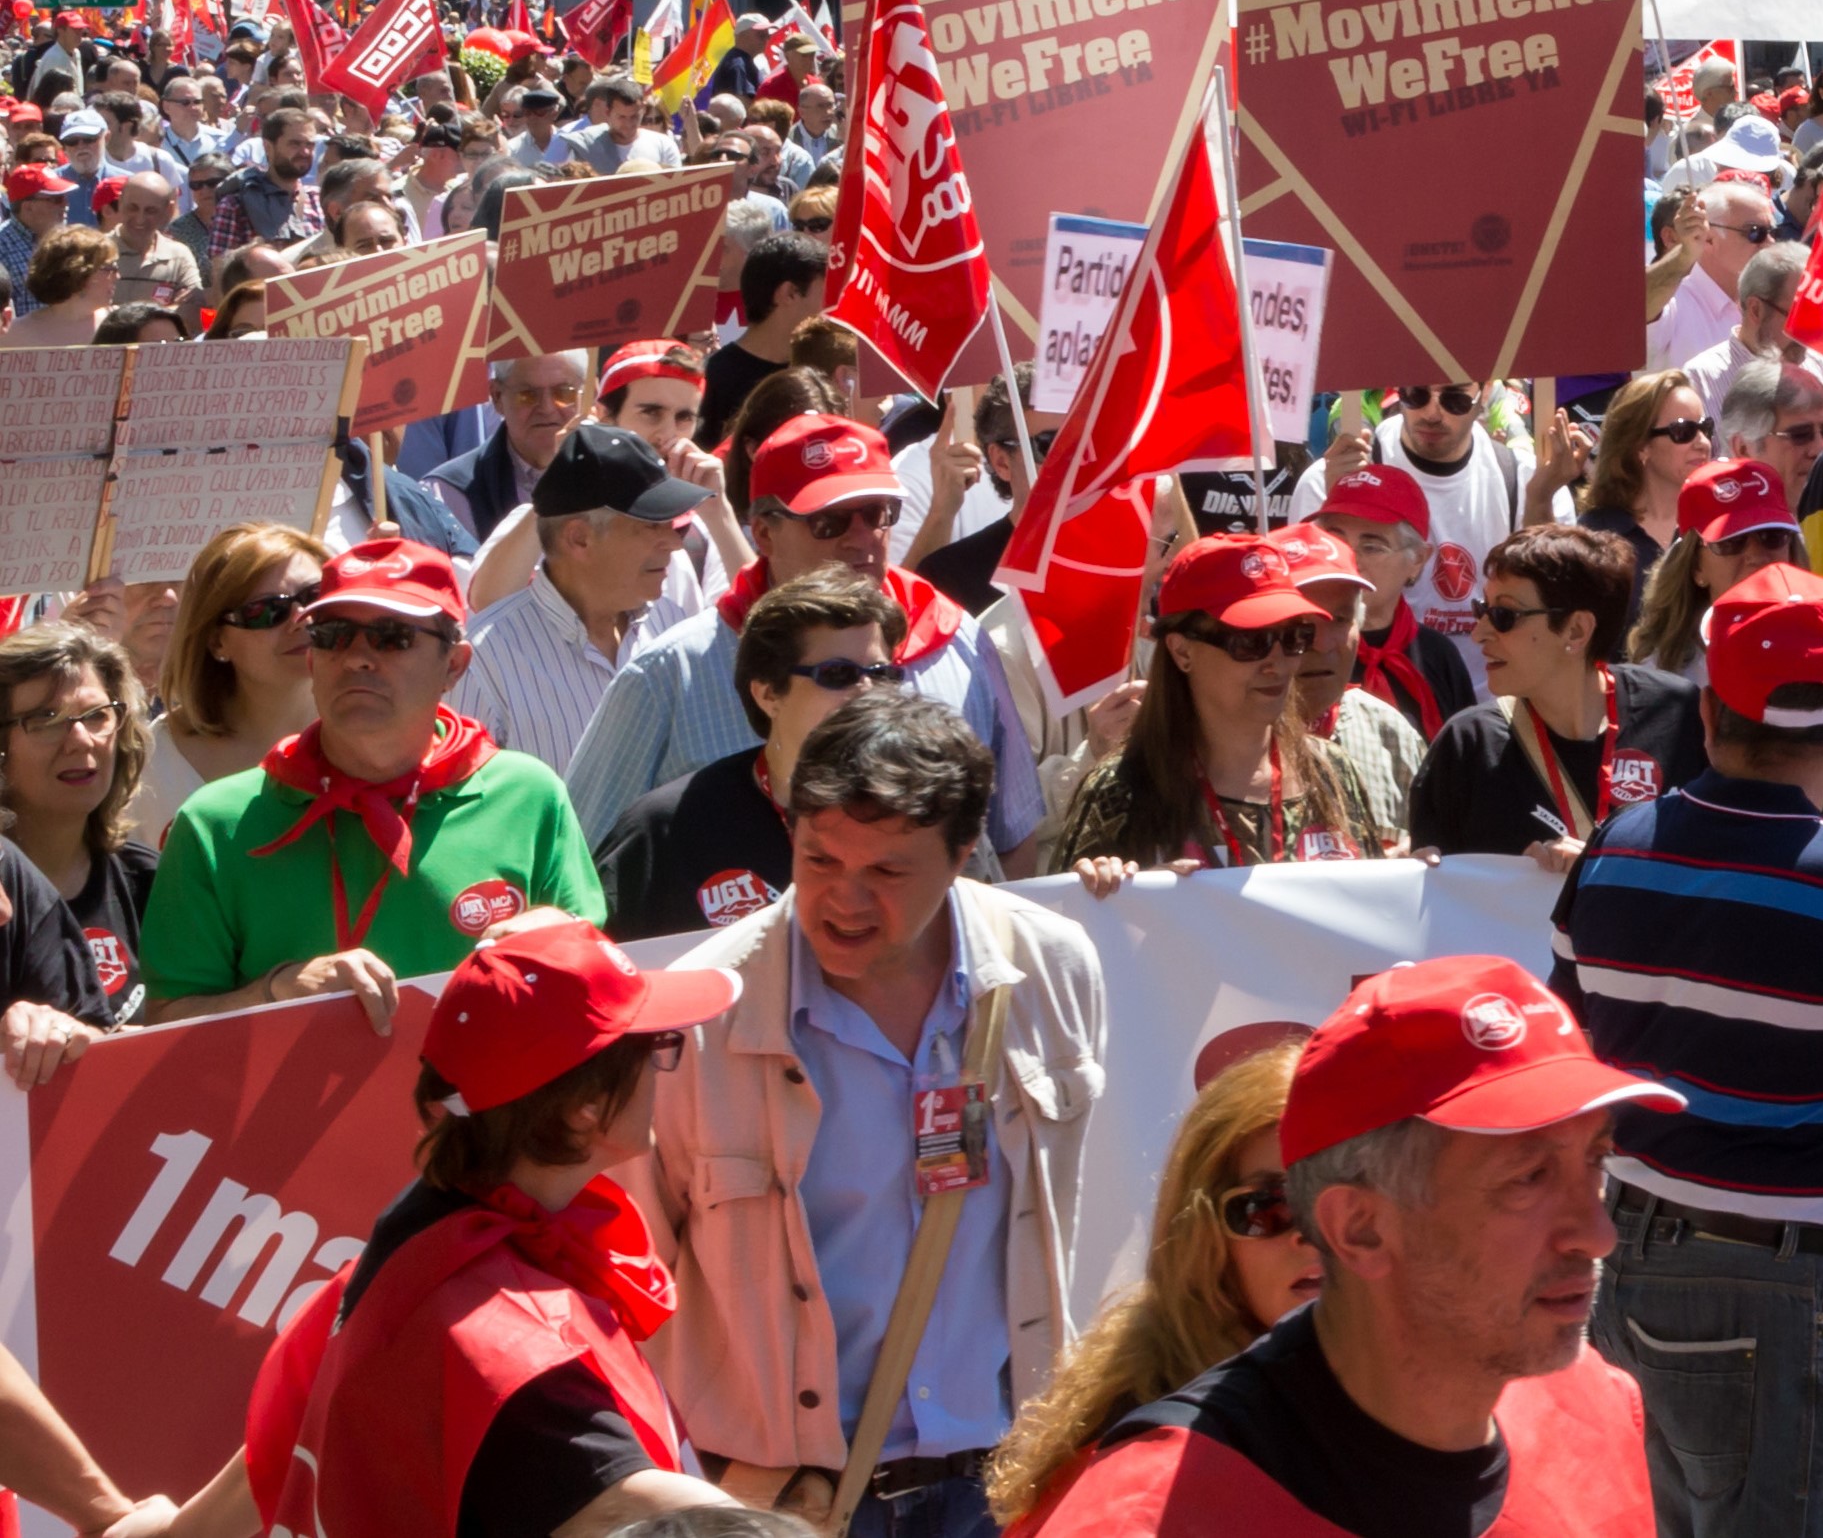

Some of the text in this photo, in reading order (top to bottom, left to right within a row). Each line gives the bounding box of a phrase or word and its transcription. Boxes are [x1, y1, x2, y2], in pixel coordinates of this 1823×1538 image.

[936, 28, 1153, 114] WeFree
[1328, 32, 1560, 111] WeFree
[1340, 64, 1561, 141] WI-FI LIBRE YA
[502, 183, 724, 263] #Movimiento
[548, 228, 679, 287] WeFree
[1055, 245, 1127, 299] Partid
[1251, 281, 1308, 342] ndes,
[702, 875, 756, 911] UGT
